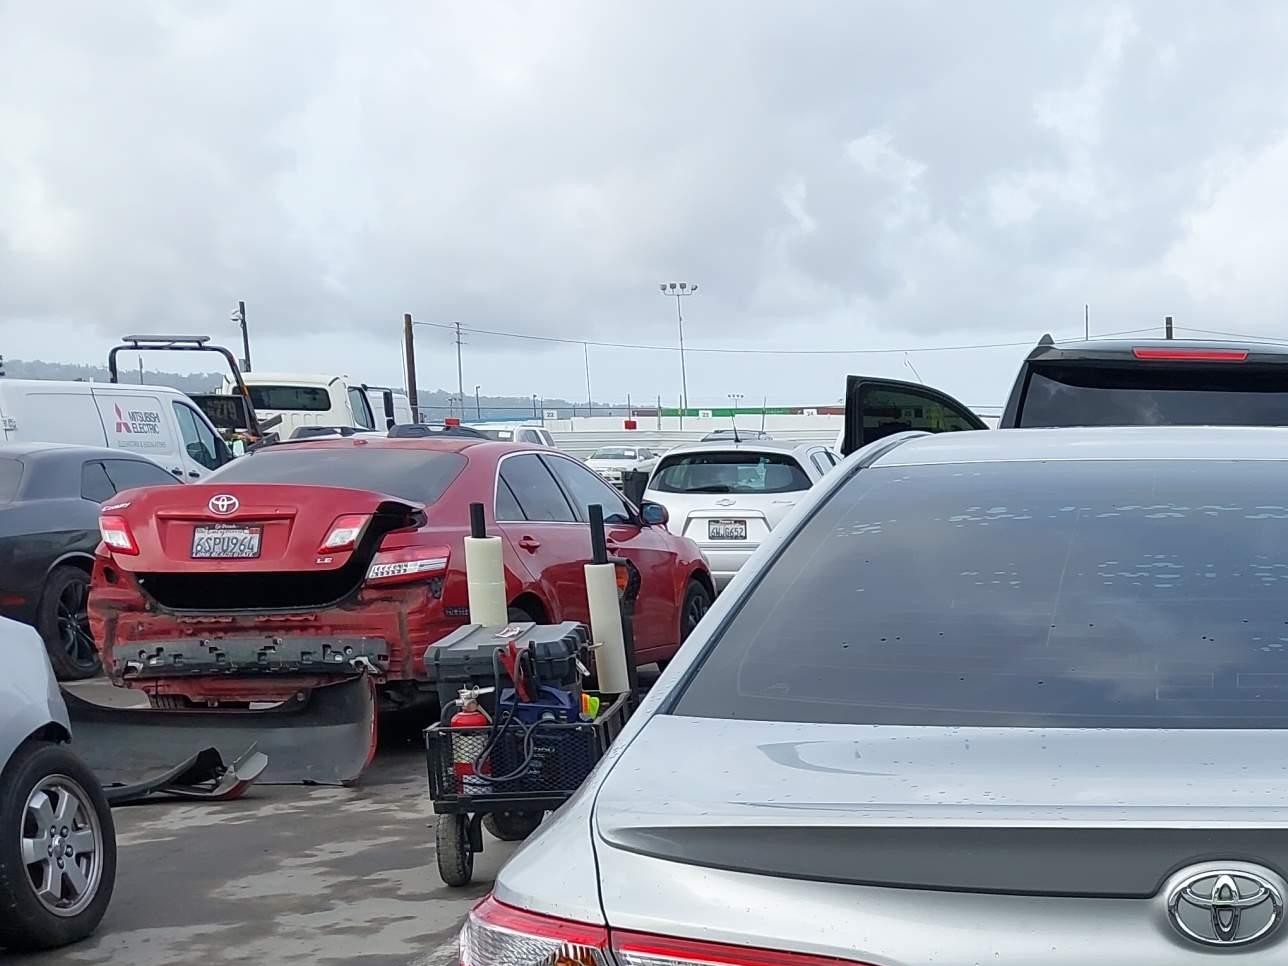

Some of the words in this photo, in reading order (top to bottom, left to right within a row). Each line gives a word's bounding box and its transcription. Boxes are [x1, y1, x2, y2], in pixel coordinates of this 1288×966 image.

[128, 411, 160, 423] MITSUBISHI
[132, 423, 160, 434] ELECTRIC
[196, 536, 255, 553] 6SPU964
